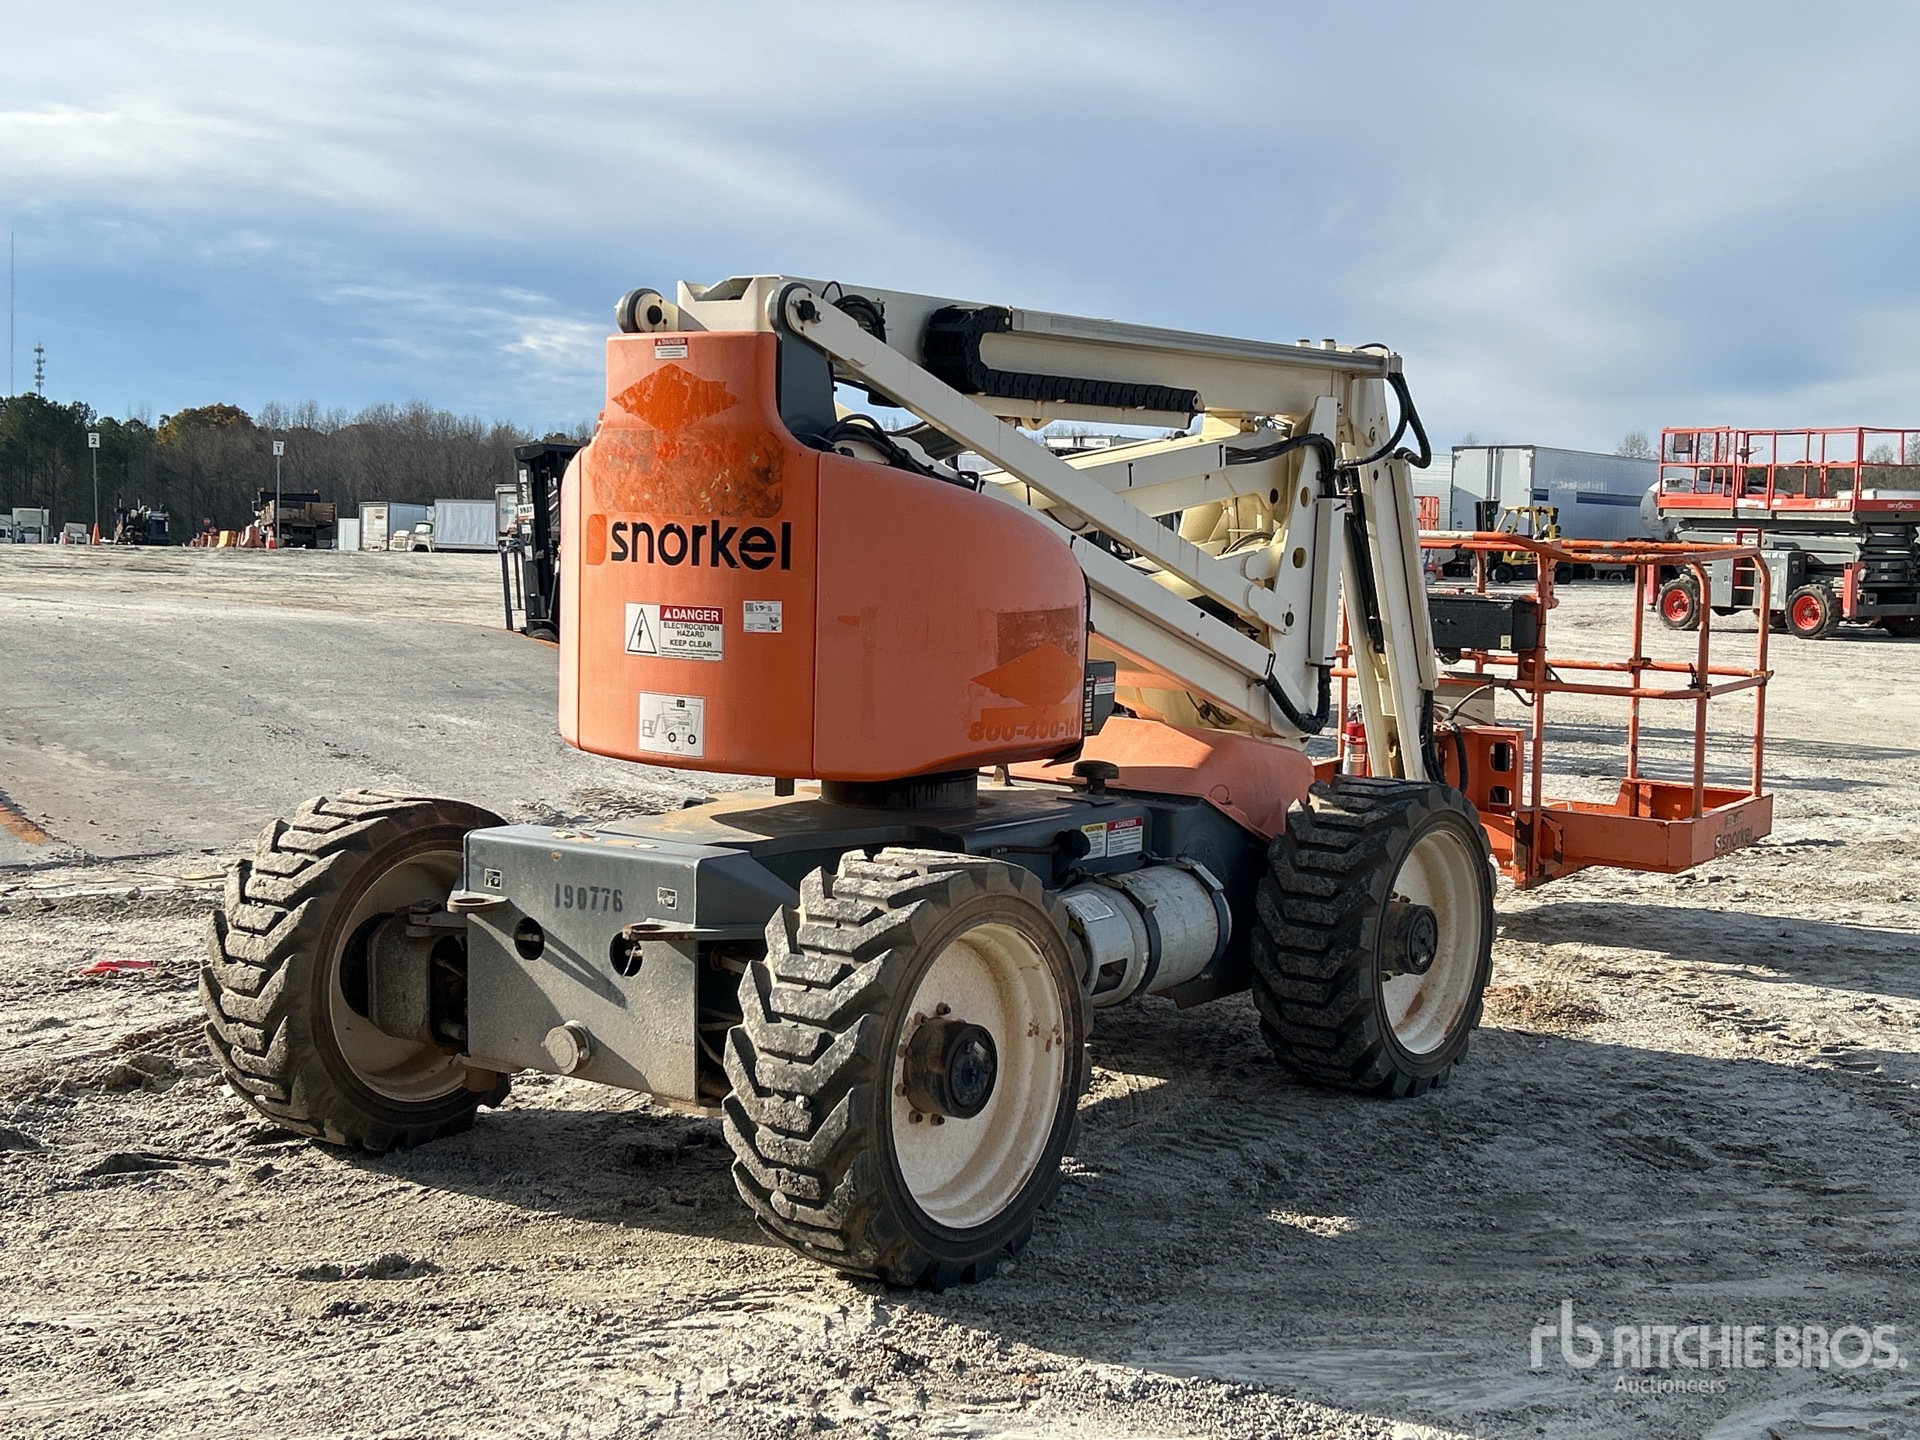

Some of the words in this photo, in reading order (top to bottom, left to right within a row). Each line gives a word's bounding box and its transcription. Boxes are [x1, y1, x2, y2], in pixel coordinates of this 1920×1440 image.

[611, 519, 792, 571] snorkel
[672, 608, 720, 622] DANGER
[663, 622, 720, 632] ELECTROCUTION
[676, 630, 705, 638] HAZARD
[688, 639, 712, 648] CLEAR
[555, 882, 624, 913] 190776
